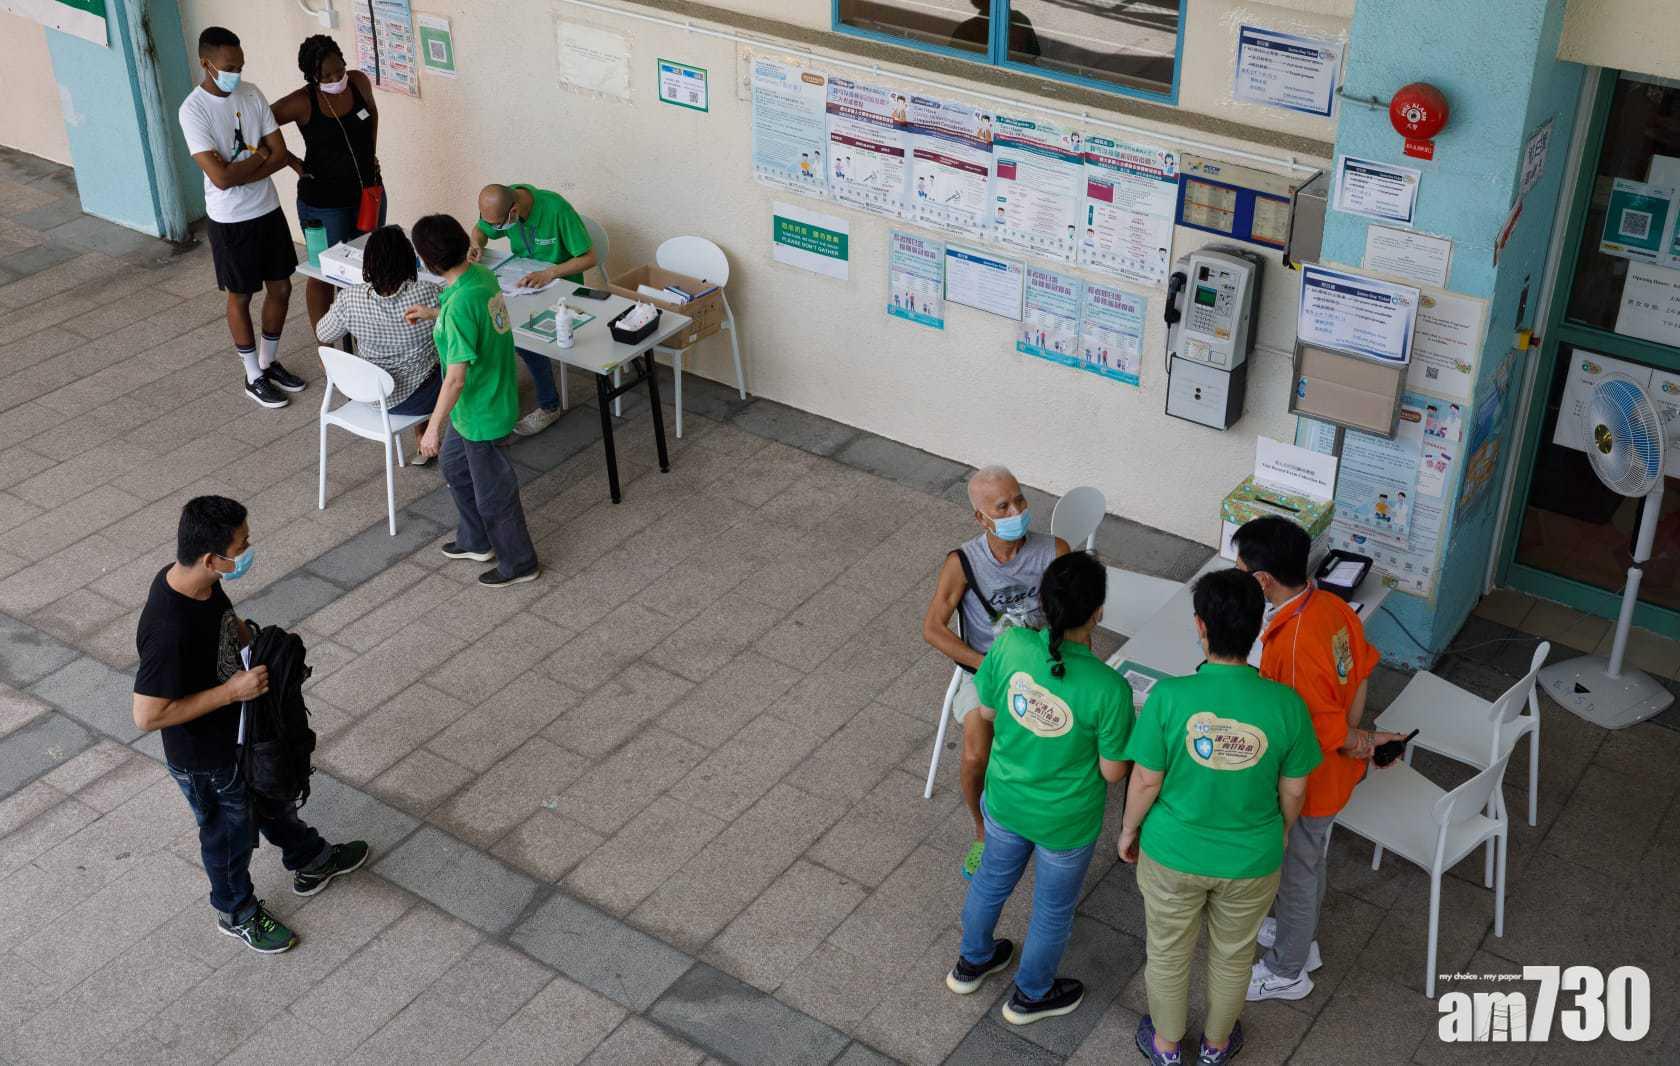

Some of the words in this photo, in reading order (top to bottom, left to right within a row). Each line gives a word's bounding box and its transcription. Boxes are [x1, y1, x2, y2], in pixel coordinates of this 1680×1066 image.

[818, 246, 839, 256] GATHER
[1215, 735, 1246, 744] 護己護人
